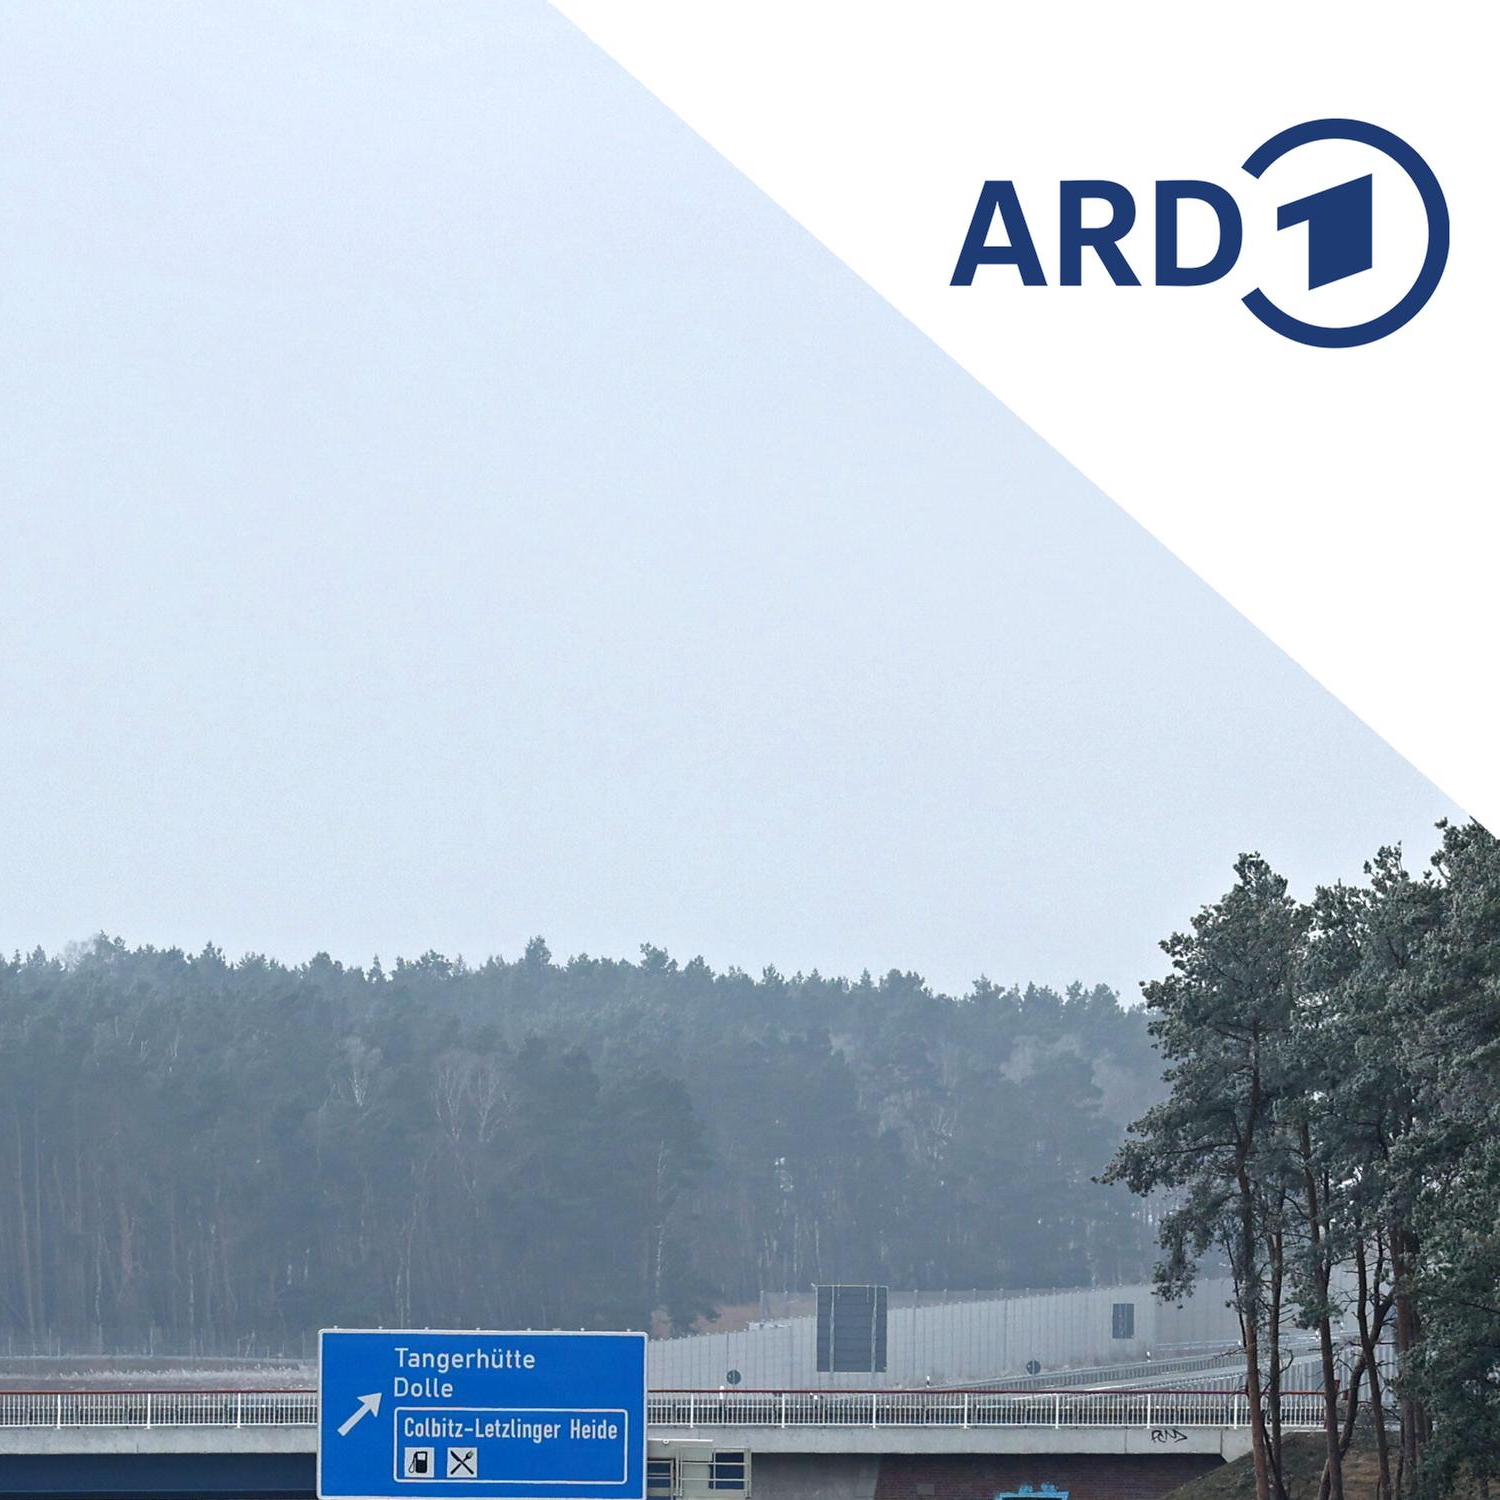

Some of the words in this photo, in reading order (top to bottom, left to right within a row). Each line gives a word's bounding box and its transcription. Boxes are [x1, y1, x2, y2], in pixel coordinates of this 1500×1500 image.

[394, 1347, 536, 1374] Tangerhütte
[393, 1376, 454, 1398] Dolle
[404, 1417, 561, 1443] Colbitz-Letzlinger
[570, 1419, 618, 1440] Heide
